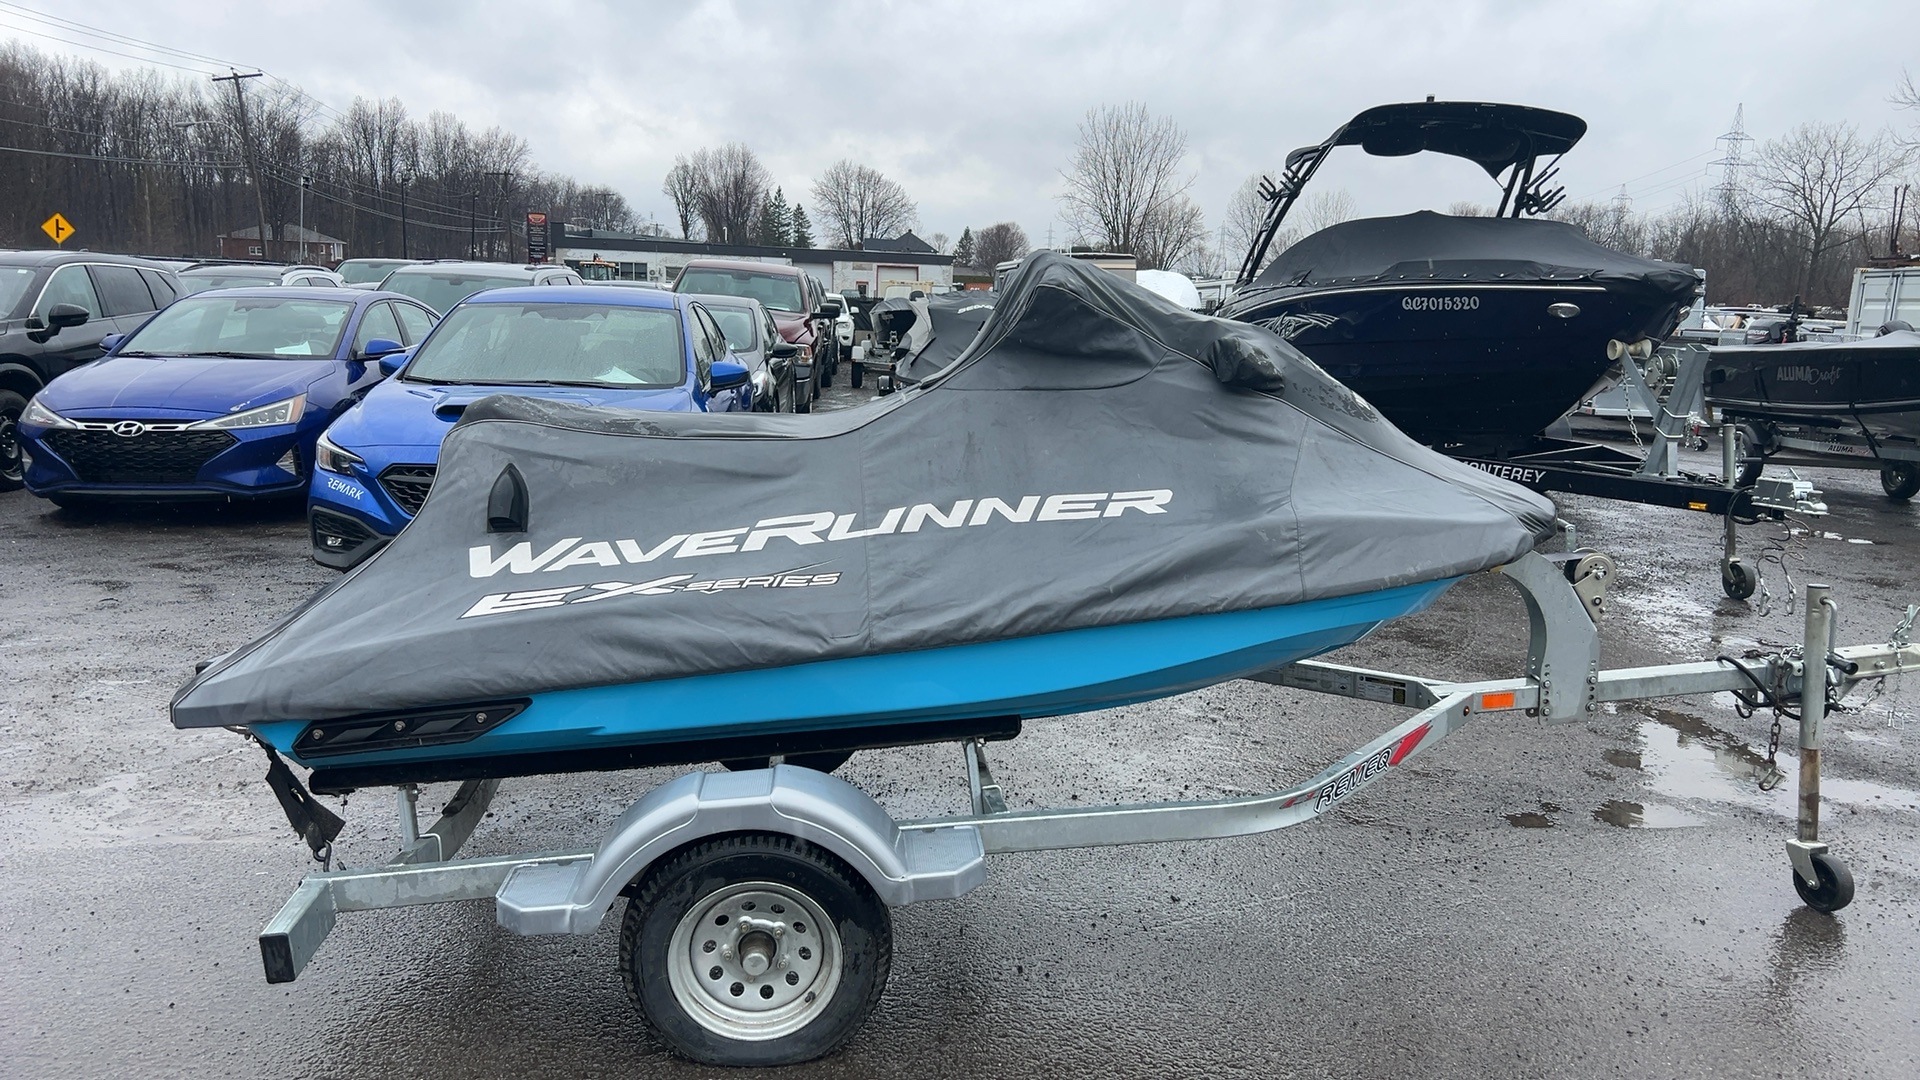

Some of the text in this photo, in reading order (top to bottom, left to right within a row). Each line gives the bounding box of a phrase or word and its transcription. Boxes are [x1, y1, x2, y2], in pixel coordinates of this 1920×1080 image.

[1402, 296, 1480, 311] QC7015320
[1463, 461, 1547, 483] NTEREY
[327, 477, 364, 500] REMARK
[682, 571, 843, 595] SERIES
[1314, 748, 1392, 813] REMEQ
